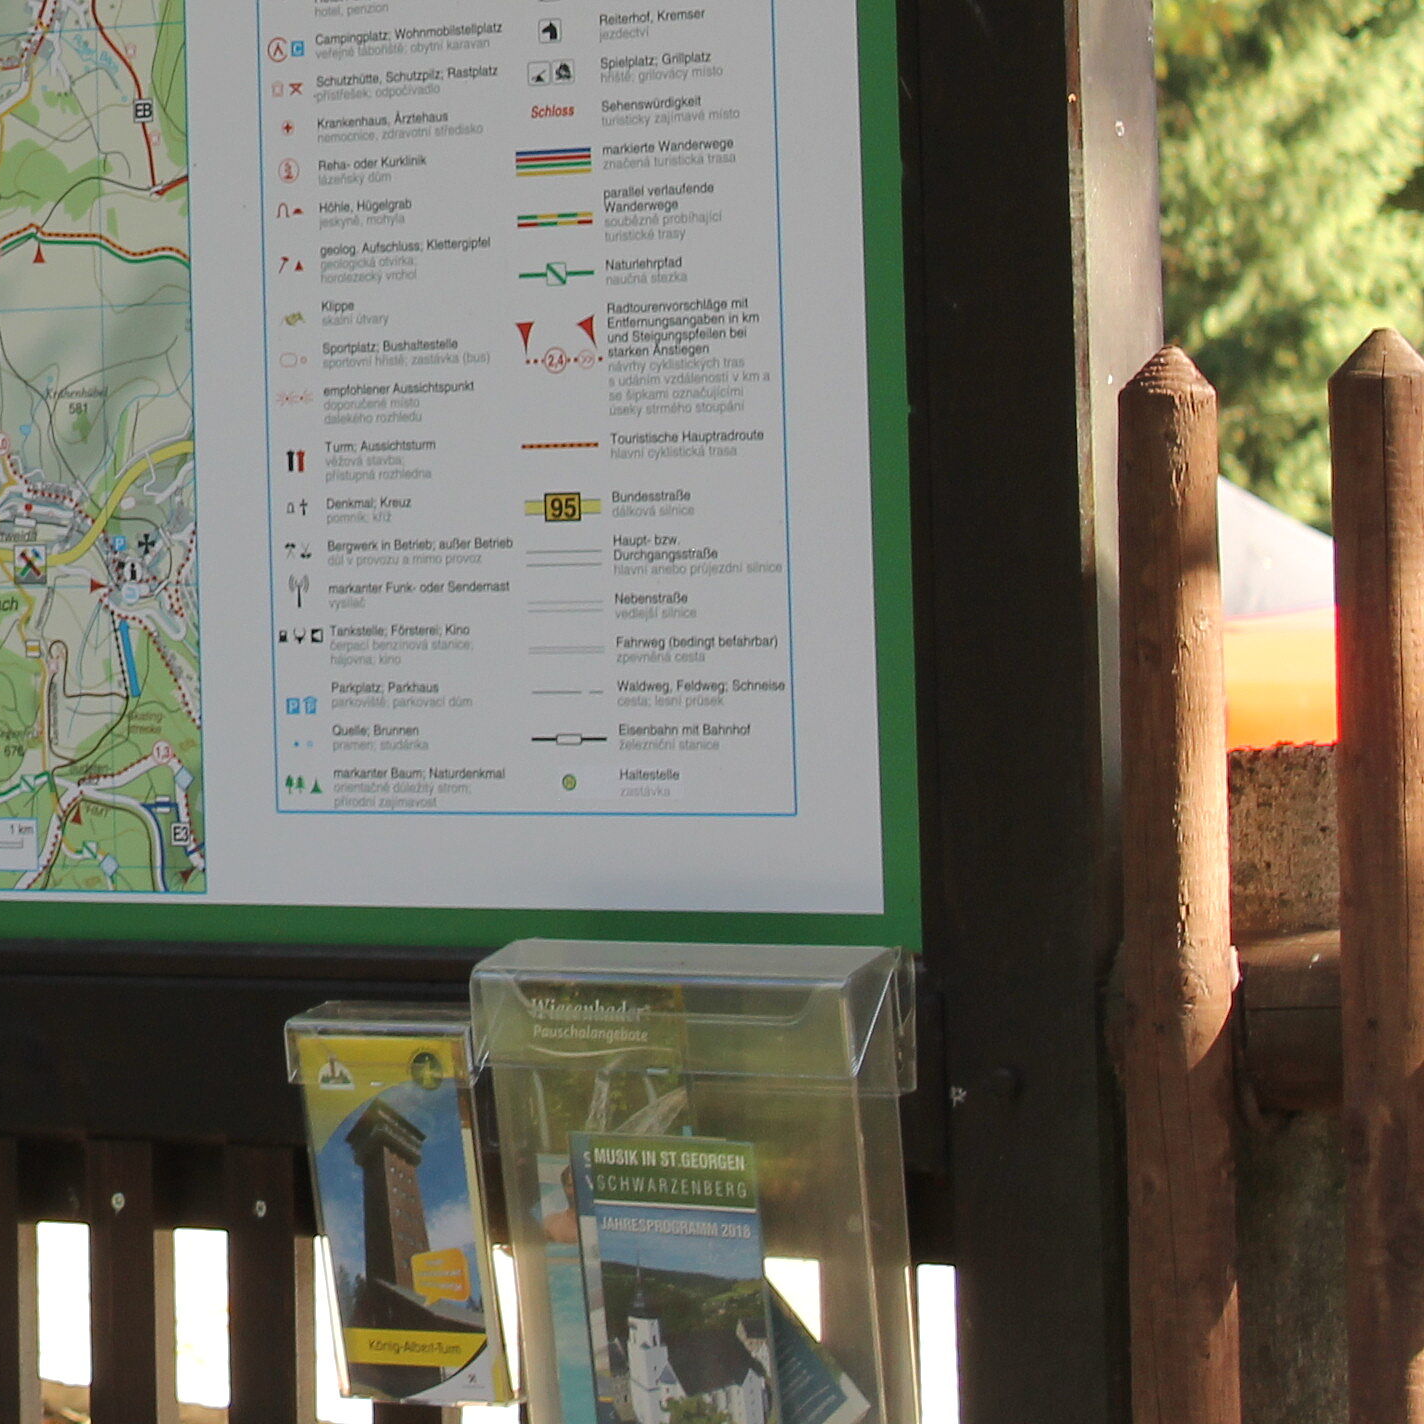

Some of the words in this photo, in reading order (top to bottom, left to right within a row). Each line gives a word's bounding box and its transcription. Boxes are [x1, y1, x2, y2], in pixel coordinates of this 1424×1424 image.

[602, 96, 701, 112] Sehenswürdigkeit
[531, 105, 575, 118] Schloss
[603, 143, 654, 155] markierte
[659, 139, 733, 152] Wanderwege
[354, 159, 377, 169] oder
[381, 156, 426, 167] Kurklinik
[606, 257, 682, 271] Naturlehrpfad
[322, 301, 354, 313] Klippe
[324, 384, 390, 398] empfohlener
[393, 381, 474, 394] Aussichtspunkt
[68, 403, 89, 414] 581
[611, 432, 678, 444] Touristische
[683, 430, 764, 444] Hauptradroute
[612, 489, 690, 503] Bundesstraße
[550, 498, 577, 518] 95
[614, 547, 717, 563] Durchgangsstraße
[329, 584, 382, 594] markanter
[420, 582, 444, 592] oder
[448, 581, 509, 592] Sendemast
[615, 592, 687, 604] Nebenstraße
[617, 636, 665, 650] Fahrweg
[669, 637, 715, 650] (bedingt
[719, 635, 777, 648] befahrbar)
[619, 724, 678, 735] Eisenbahn
[682, 725, 698, 735] mit
[703, 724, 750, 735] Bahnhof
[620, 770, 679, 780] Haltestelle
[533, 1024, 648, 1044] Pauschalangebote
[594, 1148, 638, 1167] MUSIK
[642, 1151, 656, 1168] IN
[596, 1174, 748, 1198] SCHWARZENBERG
[602, 1216, 718, 1238] JAHRESPROGRAMM
[368, 1339, 461, 1355] König-Albert-Turm
